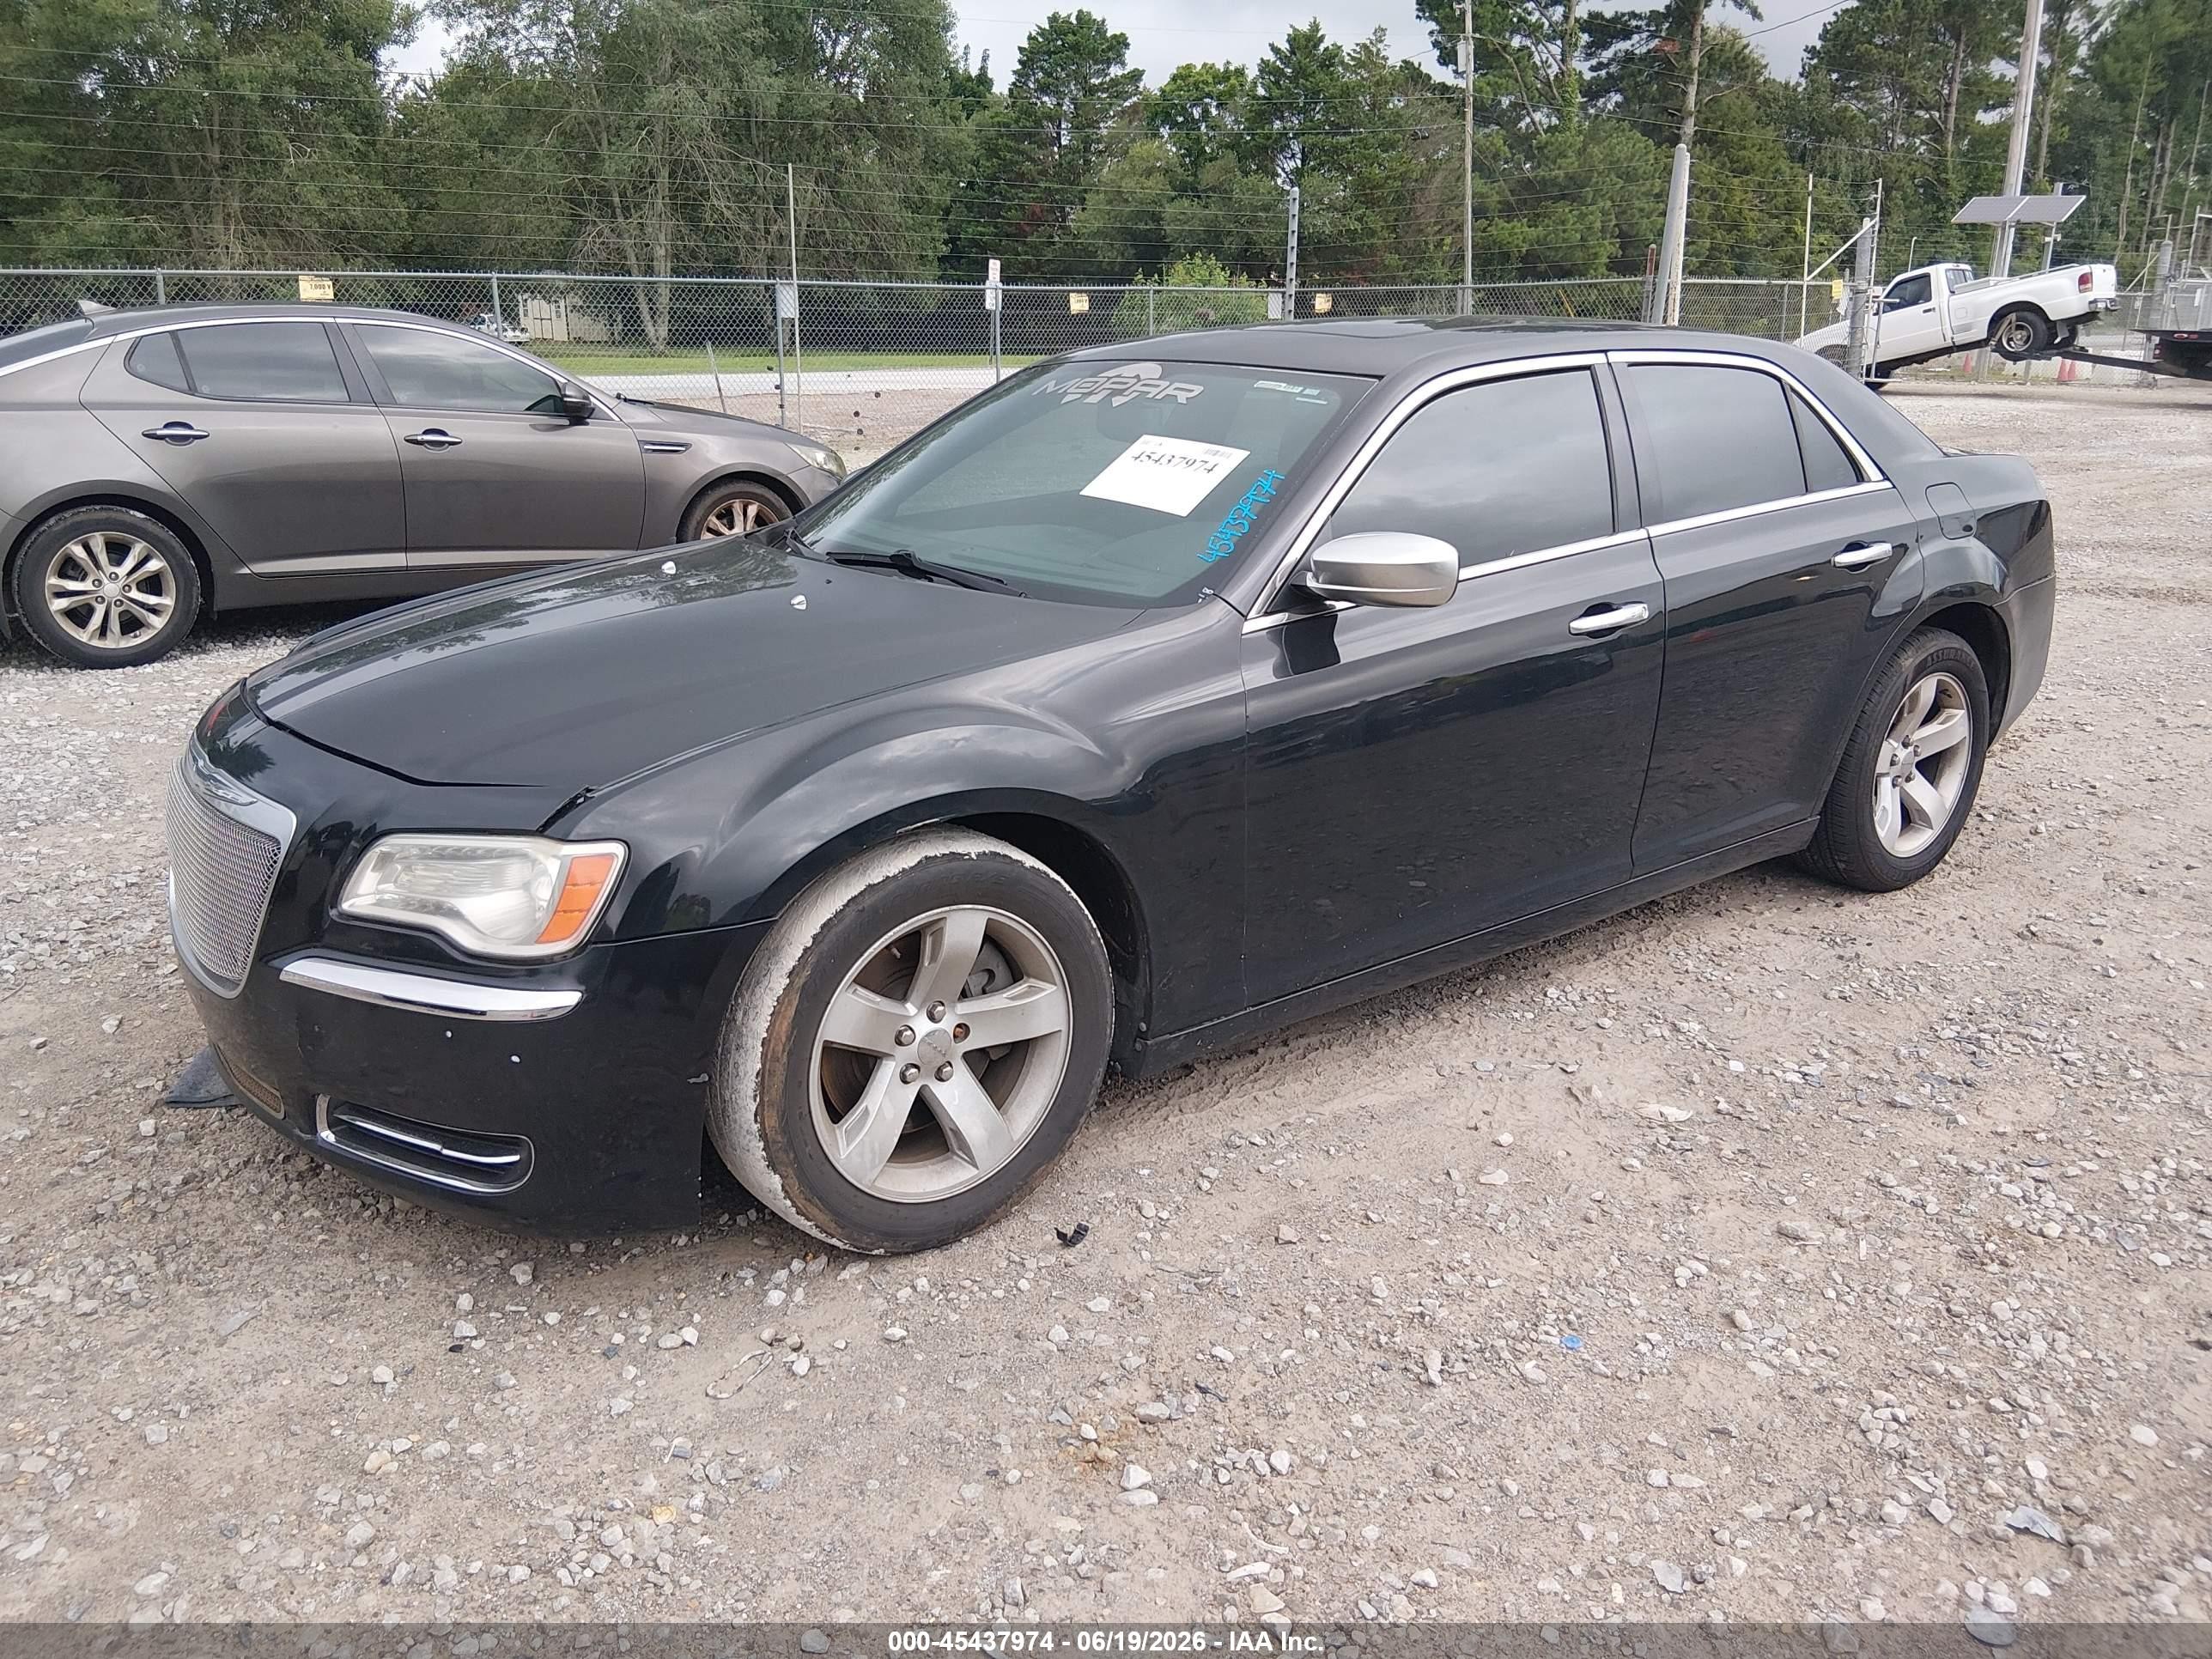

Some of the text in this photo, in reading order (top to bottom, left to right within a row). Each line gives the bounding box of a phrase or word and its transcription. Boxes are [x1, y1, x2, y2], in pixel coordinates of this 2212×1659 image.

[1031, 376, 1204, 404] MOPAR
[1132, 451, 1219, 473] 45437974
[1196, 469, 1285, 562] 45437974
